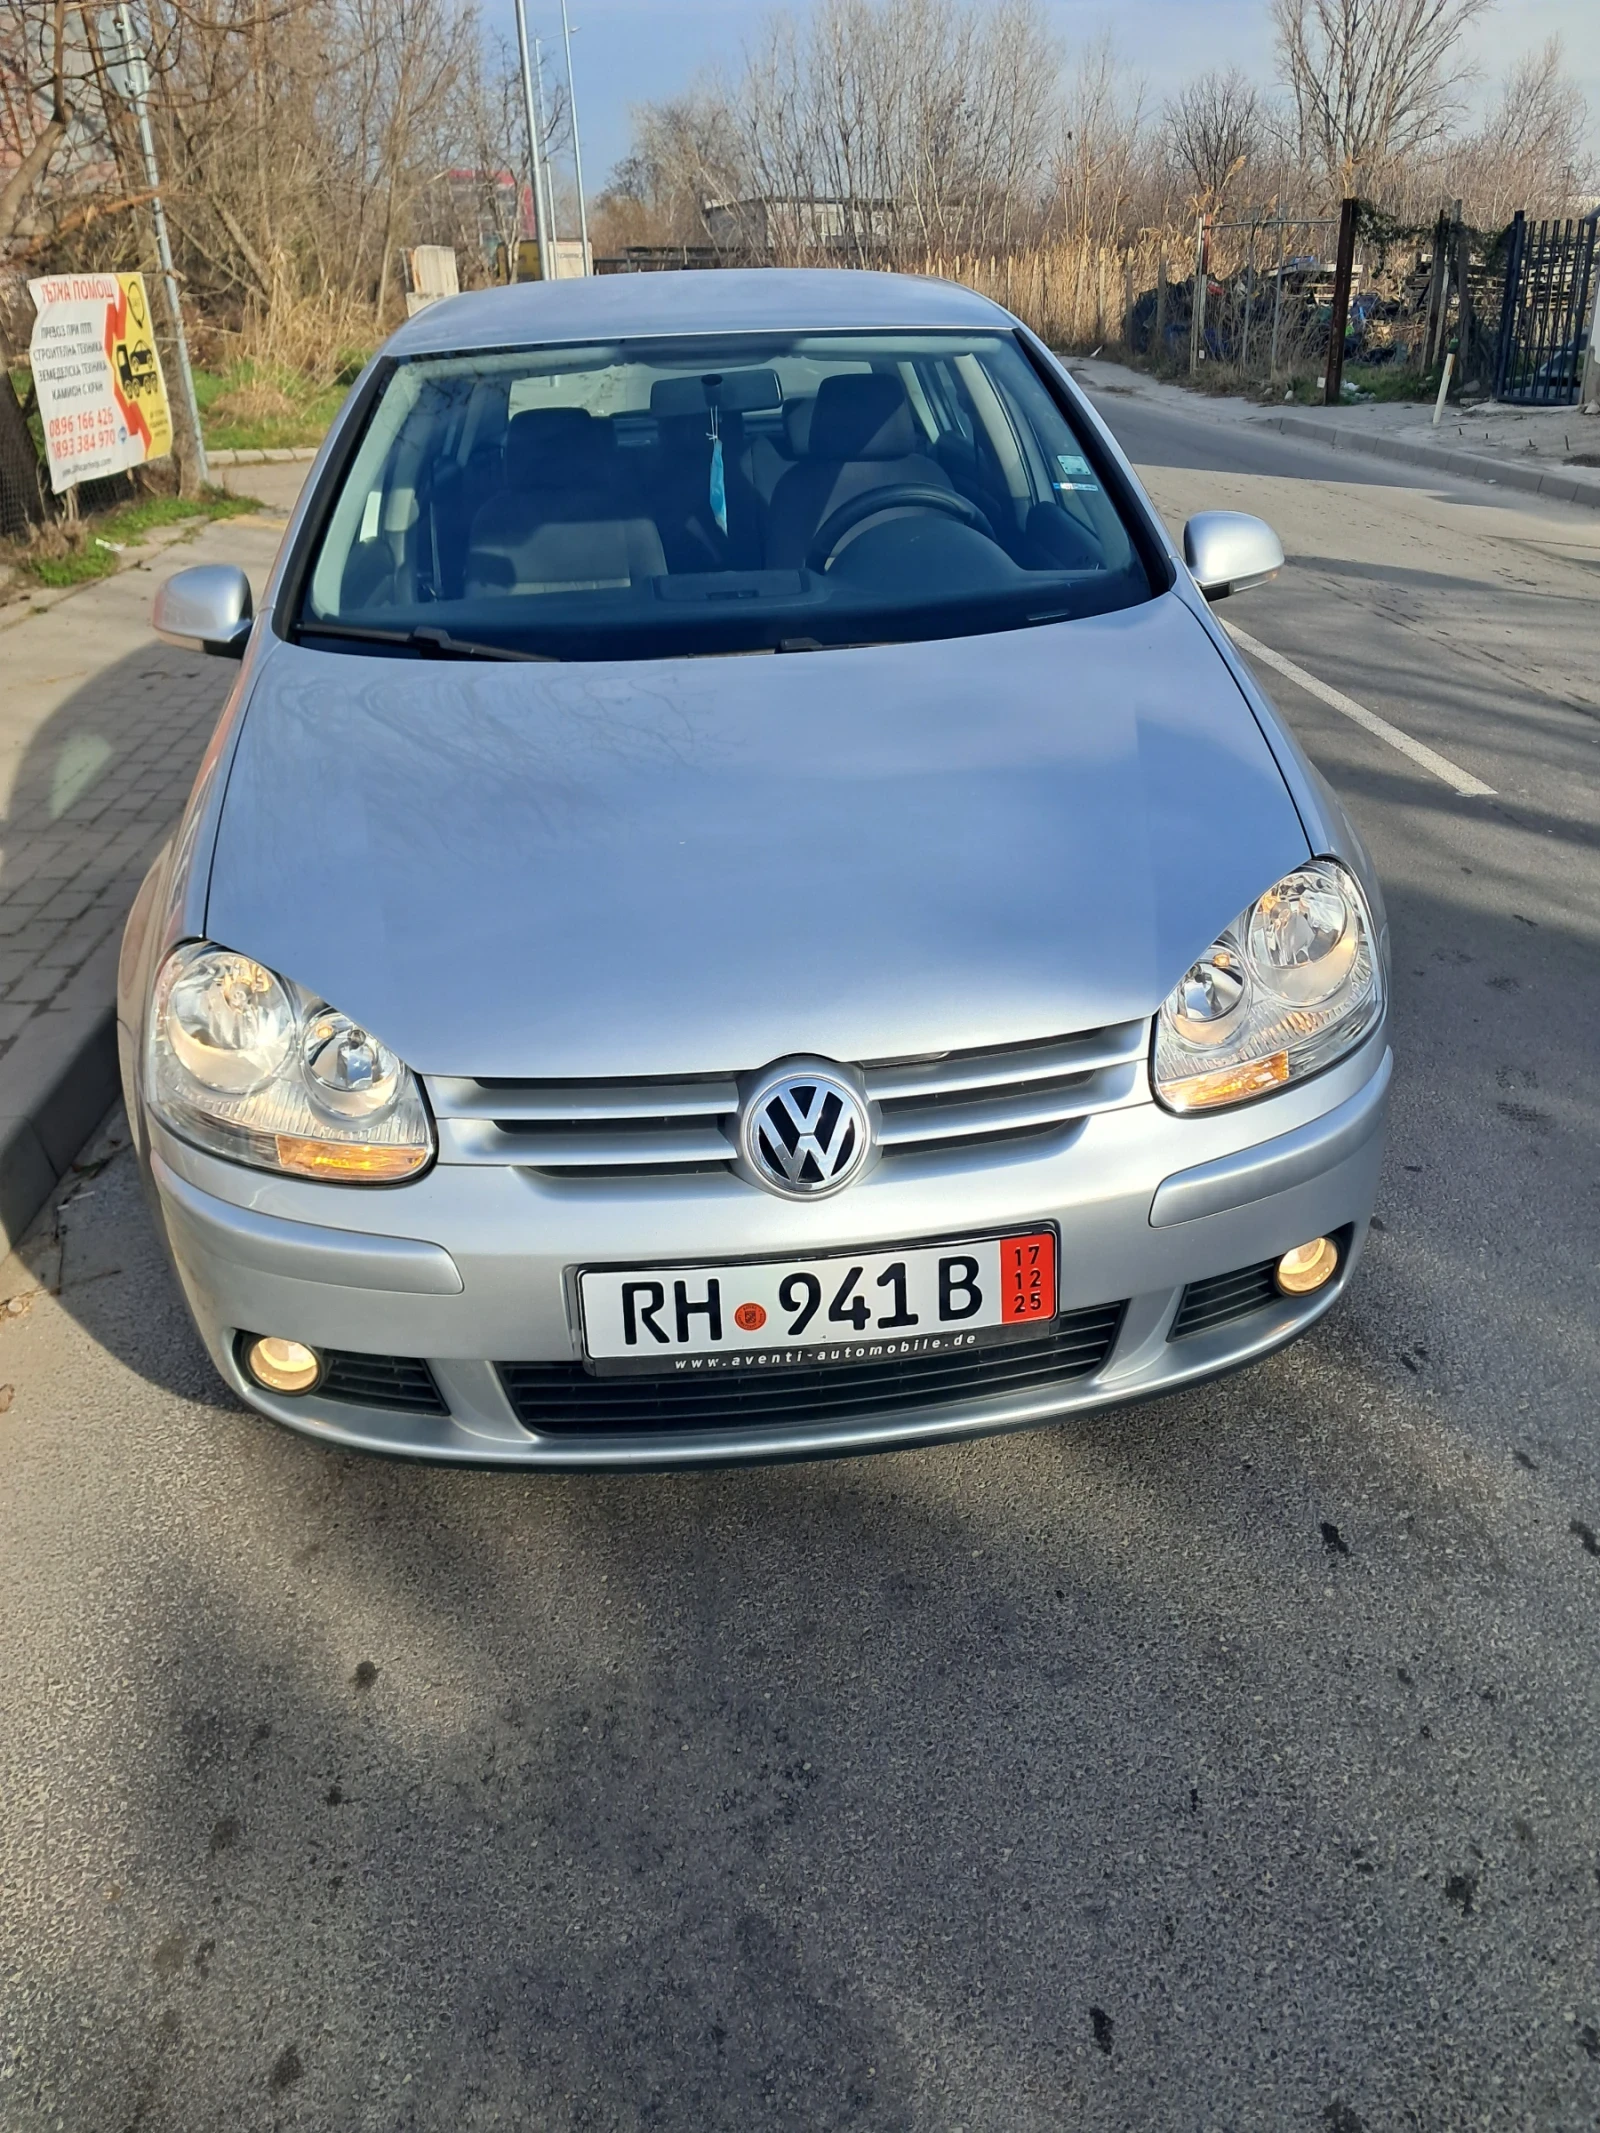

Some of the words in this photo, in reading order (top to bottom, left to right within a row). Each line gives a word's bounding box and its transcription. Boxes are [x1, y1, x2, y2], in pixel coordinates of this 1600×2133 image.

[73, 279, 115, 300] ПОМОЩ
[67, 323, 80, 336] ПРИ
[33, 344, 76, 361] СТРОИТЕЛНА
[77, 341, 103, 355] ТЕХНИКА
[38, 364, 81, 382] ЗЕМЕДЕЛСКА
[81, 360, 107, 375] ТЕХНИКА
[52, 385, 81, 400] КАМИОН
[49, 415, 74, 438] 0896
[77, 411, 95, 431] 166
[97, 406, 114, 426] 426
[76, 433, 96, 453] 384
[98, 428, 116, 448] 970
[1014, 1243, 1041, 1267] 17
[1014, 1267, 1042, 1290] 12
[621, 1277, 723, 1346] RH
[778, 1261, 920, 1336] 941
[938, 1254, 984, 1322] B
[1013, 1290, 1042, 1314] 25
[674, 1333, 977, 1370] www.aventi-automobile.de
